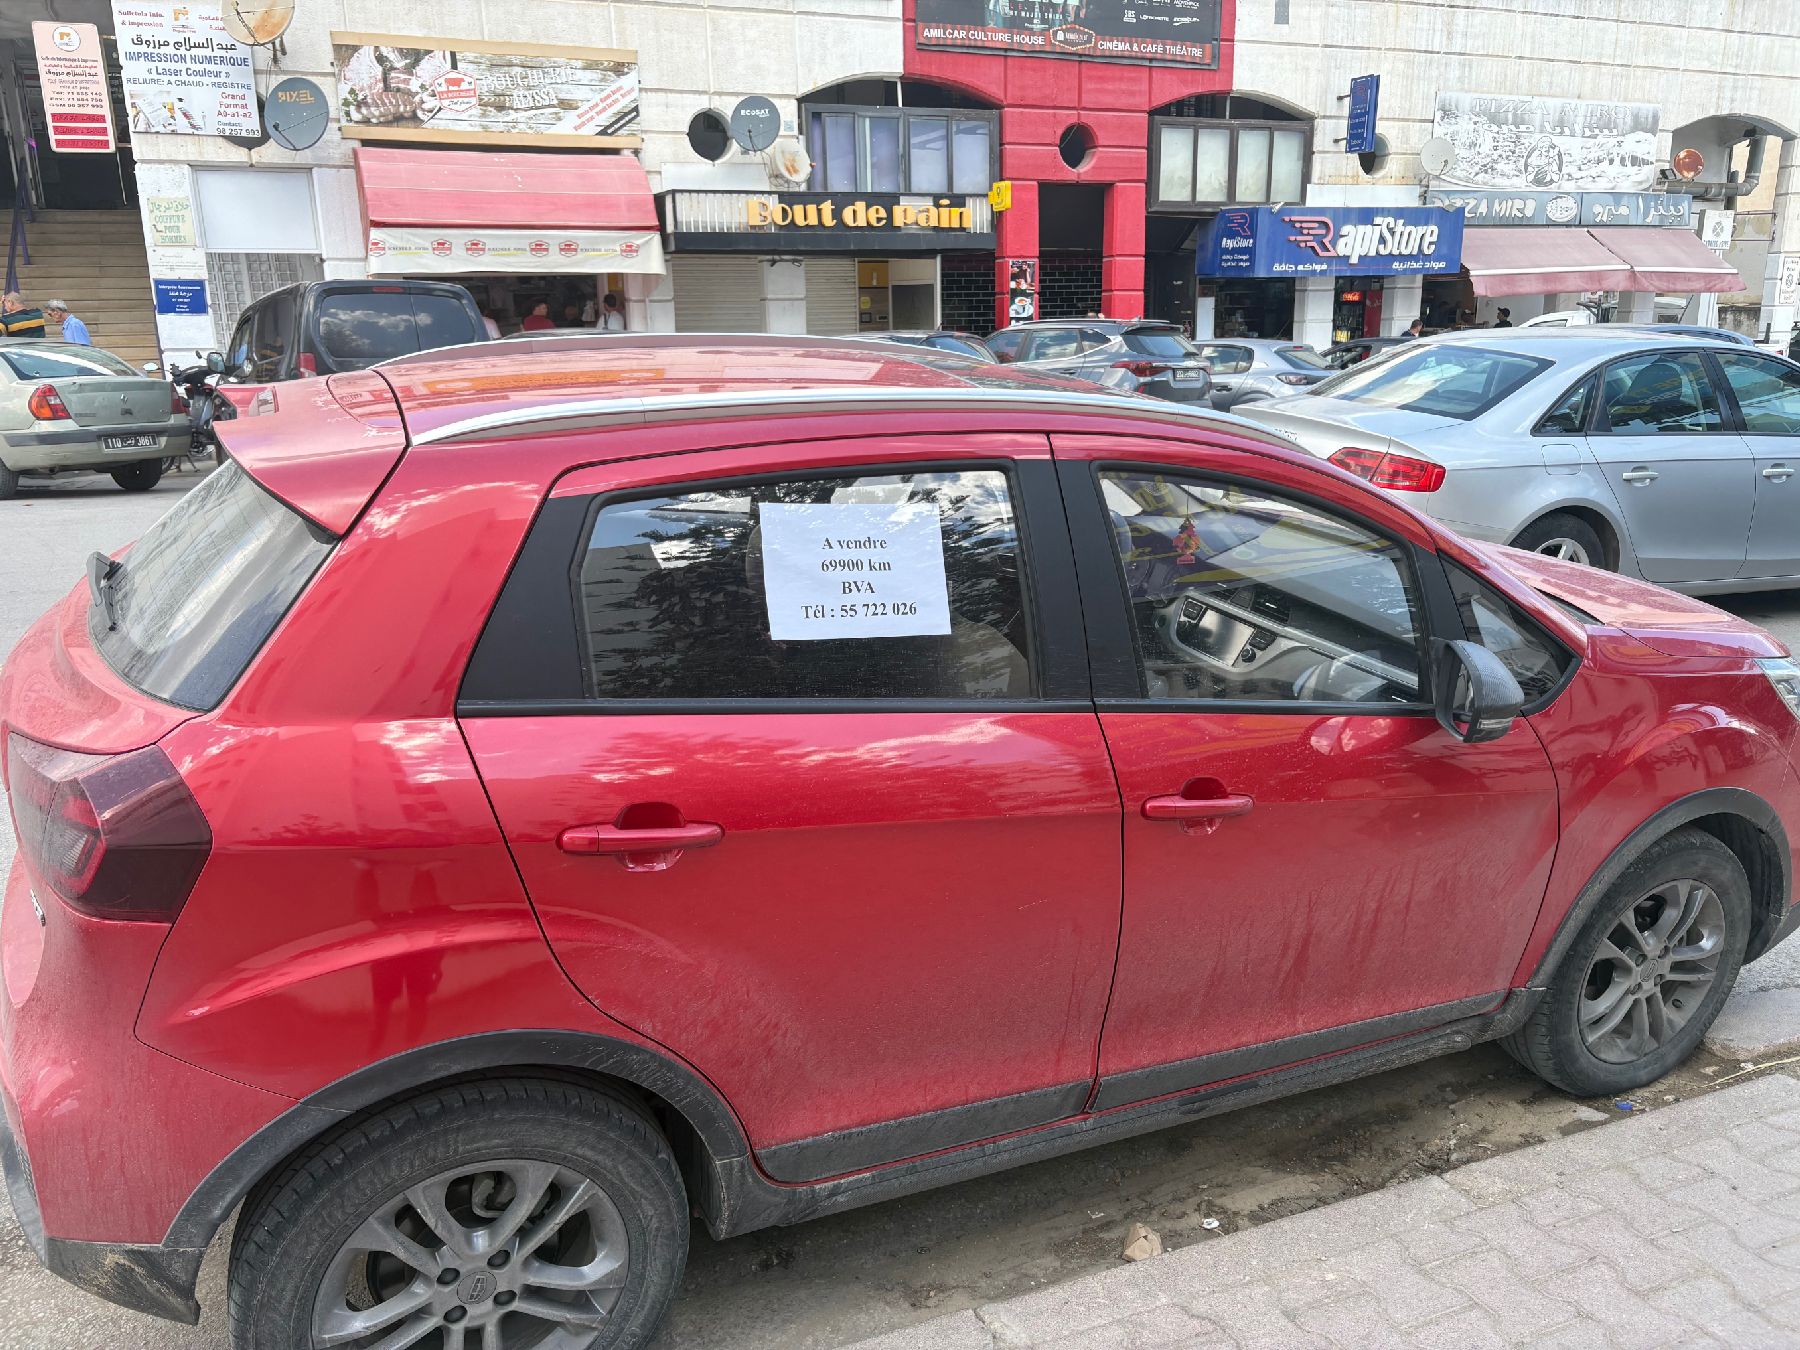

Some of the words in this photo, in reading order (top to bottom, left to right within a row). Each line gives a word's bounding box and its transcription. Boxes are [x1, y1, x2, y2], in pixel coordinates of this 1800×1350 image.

[131, 34, 170, 49] مرزوق
[924, 28, 966, 39] AMILCAR
[968, 30, 1012, 42] CULTURE
[1014, 34, 1046, 45] HOUSE
[173, 37, 214, 52] السلام
[216, 42, 238, 52] عبد
[1098, 40, 1130, 51] CINÉMA
[1132, 43, 1139, 52] &
[1140, 42, 1164, 53] CAFÉ
[125, 52, 187, 64] IMPRESSION
[190, 55, 250, 67] NUMERIQUE
[155, 66, 182, 76] Laser
[185, 68, 222, 78] Couleur
[482, 66, 576, 91] BOUCHERIE
[211, 82, 252, 90] REGISTRE
[221, 92, 246, 100] Grand
[219, 101, 249, 109] Format
[1472, 98, 1550, 114] PIZZA
[1560, 103, 1632, 120] MIRO
[1482, 122, 1535, 134] ميرو
[748, 200, 838, 227] Bout
[842, 202, 887, 227] de
[893, 198, 972, 228] pain
[1432, 197, 1487, 218] PZZA
[1492, 198, 1537, 218] MIRO
[1592, 202, 1630, 221] ميرو
[1638, 195, 1685, 223] بيتزا
[154, 214, 186, 224] COIFFURE
[1221, 236, 1253, 251] RapiStore
[1283, 216, 1438, 264] RapiStore
[1272, 262, 1296, 271] جافة
[1297, 262, 1328, 271] فواكه
[1392, 260, 1423, 270] غذائية
[108, 438, 121, 448] 110
[822, 537, 833, 549] A
[837, 536, 887, 549] vendre
[822, 559, 864, 572] 69900
[868, 559, 891, 571] km
[842, 581, 875, 594] BVA
[801, 604, 825, 619] Tél
[840, 604, 858, 618] 55
[863, 602, 888, 616] 722
[892, 602, 917, 616] 026
